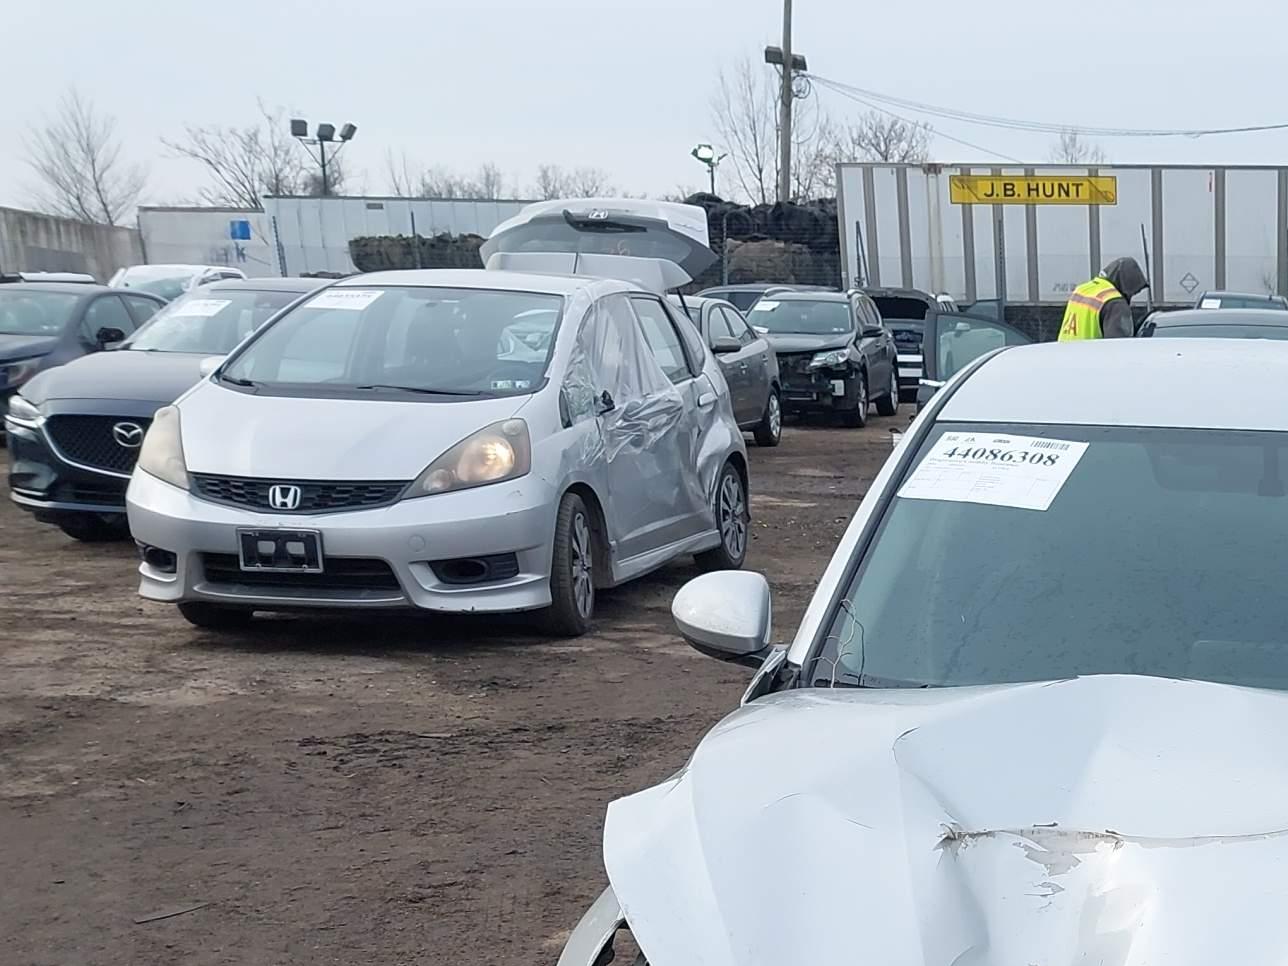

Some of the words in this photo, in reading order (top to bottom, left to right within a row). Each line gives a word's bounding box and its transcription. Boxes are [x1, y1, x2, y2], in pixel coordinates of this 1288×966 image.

[983, 182, 1021, 198] J.B.
[1027, 182, 1084, 198] HUNT
[943, 446, 1061, 467] 44086308
